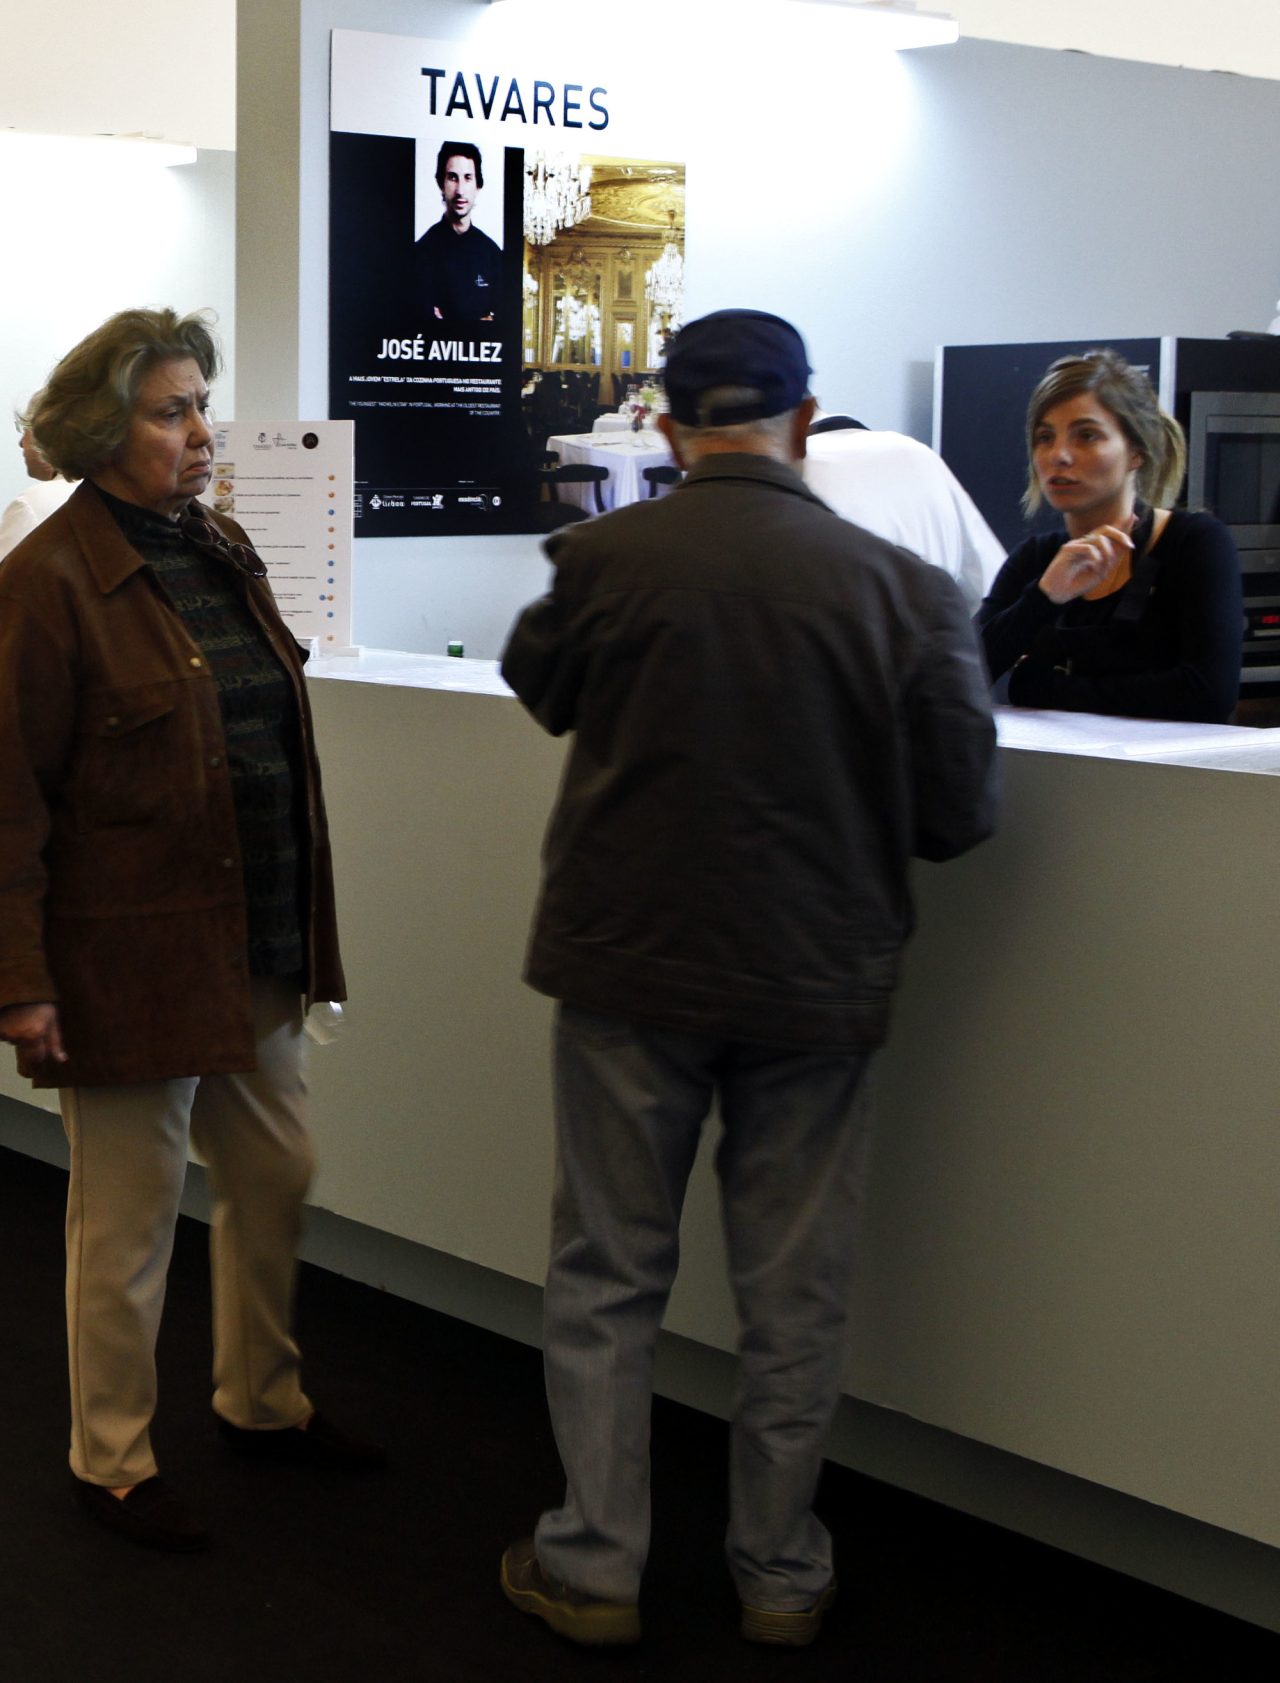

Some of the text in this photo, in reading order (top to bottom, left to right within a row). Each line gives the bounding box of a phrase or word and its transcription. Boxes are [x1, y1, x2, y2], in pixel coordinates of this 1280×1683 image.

[420, 67, 609, 131] TAVARES
[377, 334, 503, 362] JOSÉ AVILLEZ
